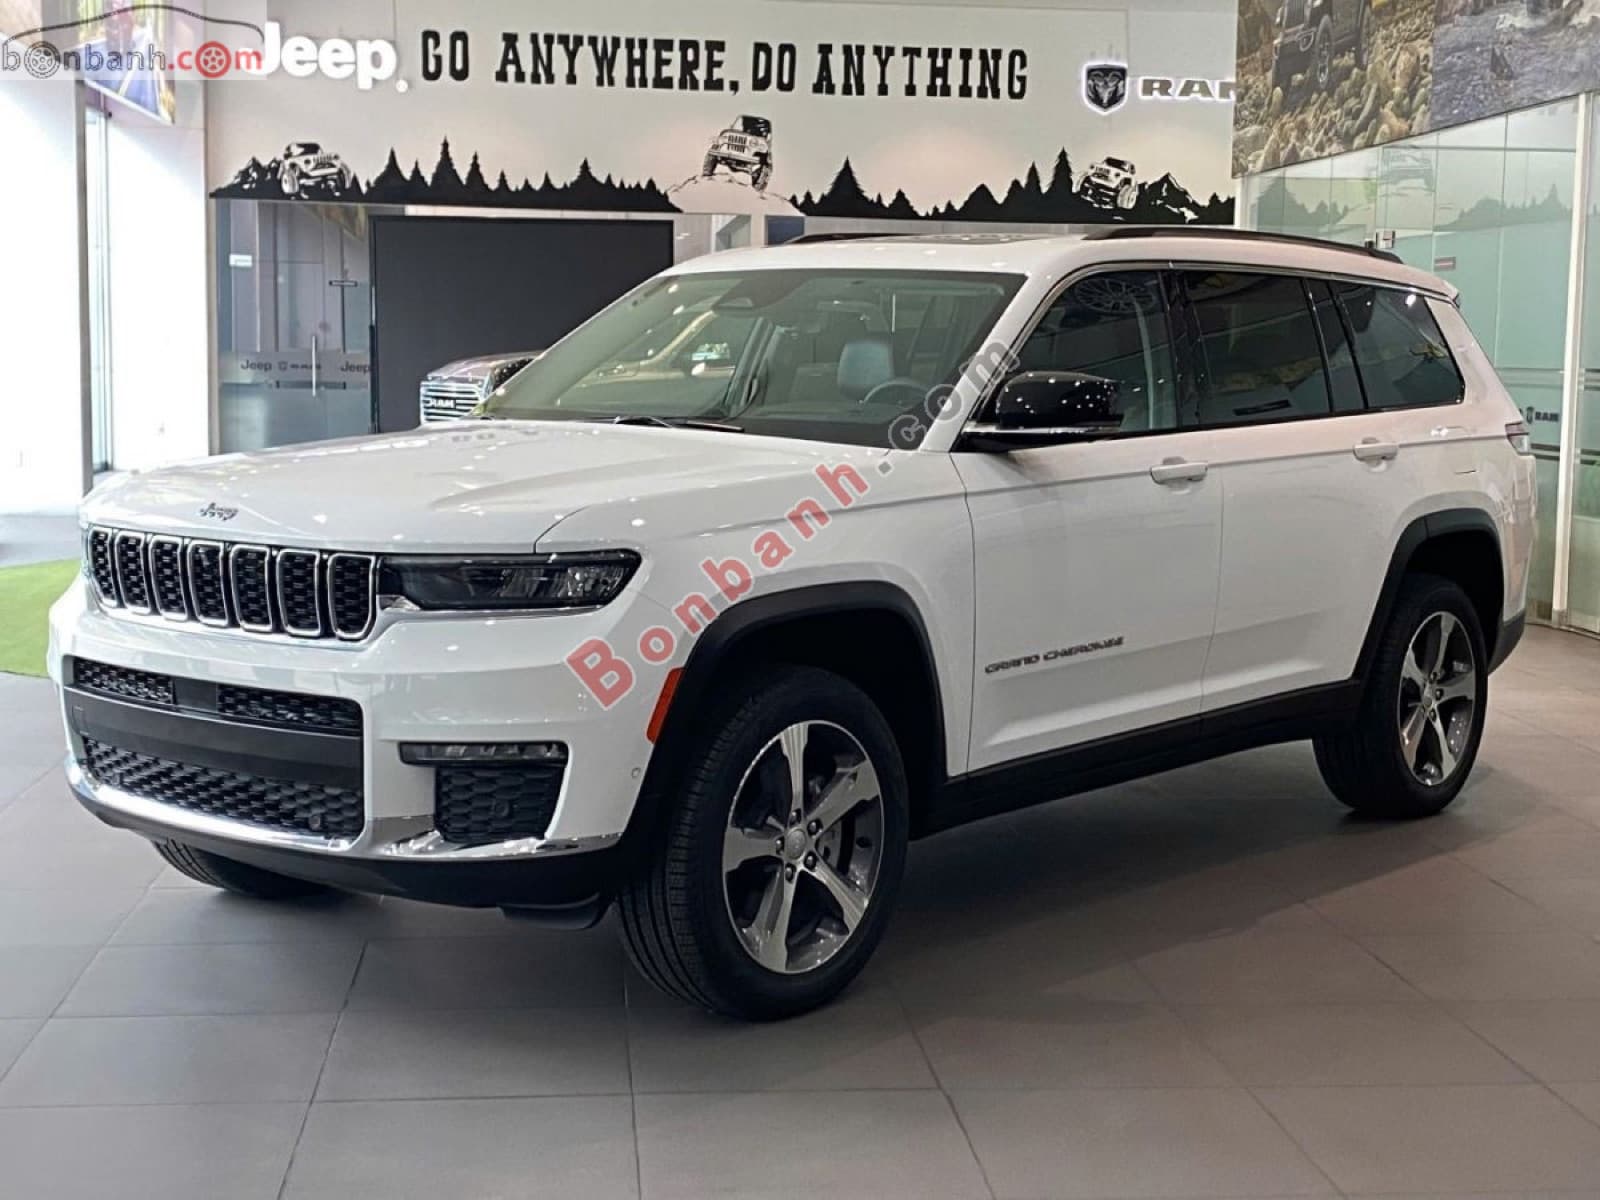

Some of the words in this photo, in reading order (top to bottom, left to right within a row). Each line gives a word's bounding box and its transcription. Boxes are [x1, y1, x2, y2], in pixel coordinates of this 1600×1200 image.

[421, 30, 469, 82] GO
[495, 32, 739, 96] ANYWHERE,
[752, 42, 796, 93] DO
[812, 43, 1028, 100] ANYTHING
[240, 360, 273, 373] Jeep
[1535, 411, 1559, 422] RAM
[985, 654, 1040, 674] GRAND
[1043, 636, 1124, 661] CHEROKEE
